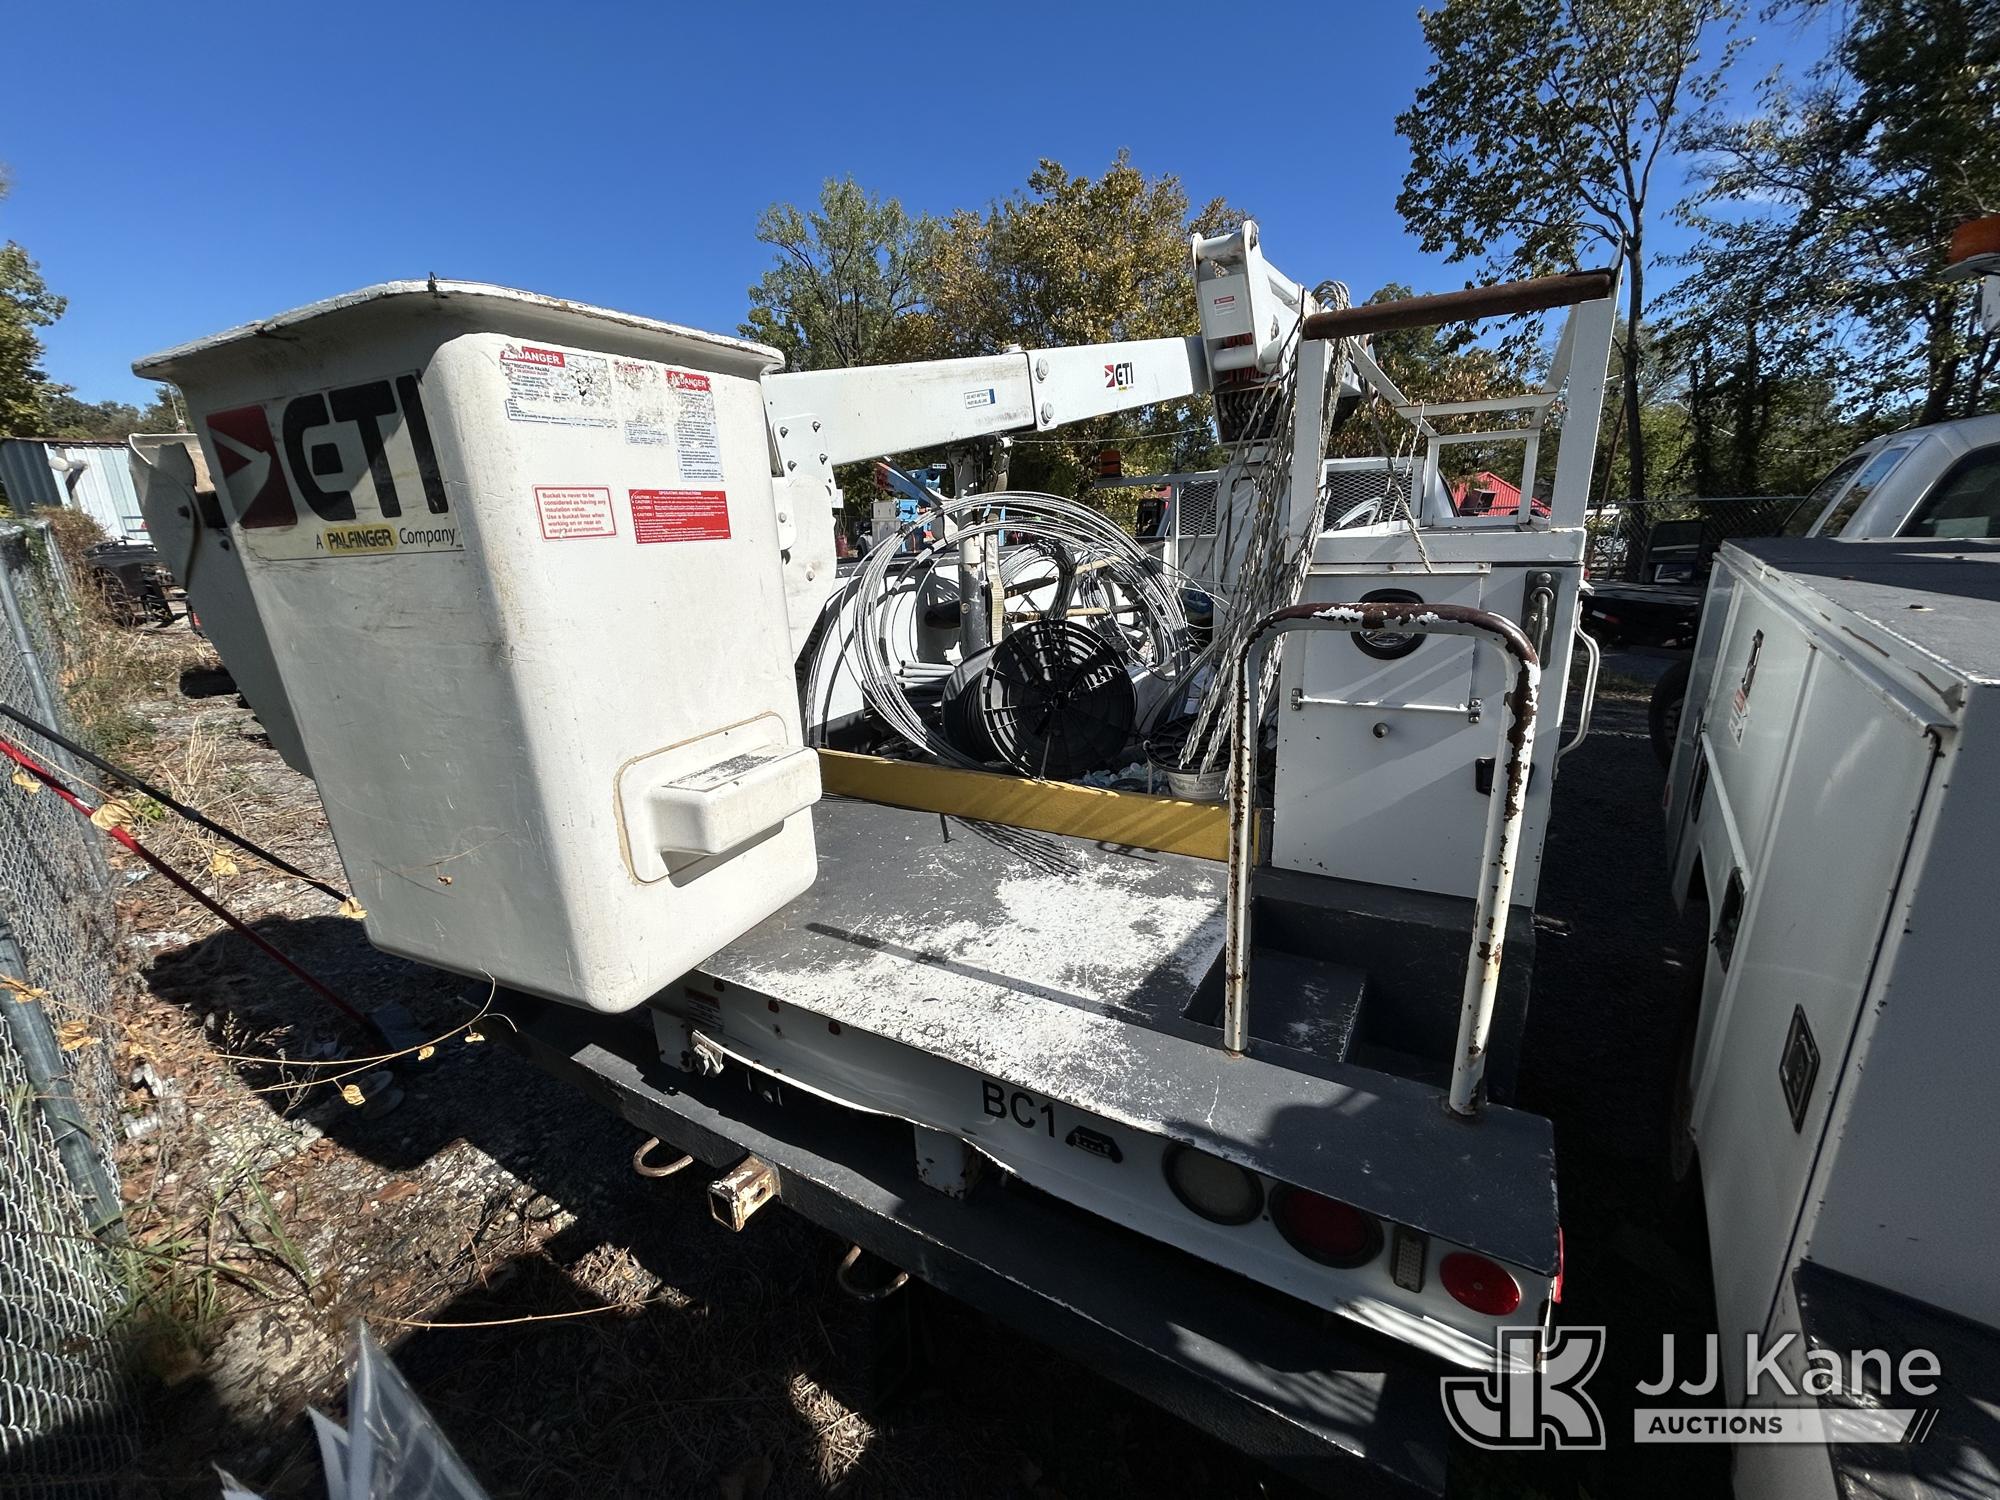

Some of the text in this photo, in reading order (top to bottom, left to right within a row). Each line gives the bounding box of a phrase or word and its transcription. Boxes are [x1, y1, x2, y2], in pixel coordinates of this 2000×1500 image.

[518, 351, 561, 364] DANGER
[1115, 361, 1134, 386] ETI
[282, 374, 449, 522] ETI
[316, 527, 456, 550] A PALFINGER Company
[982, 1080, 1055, 1138] BC1
